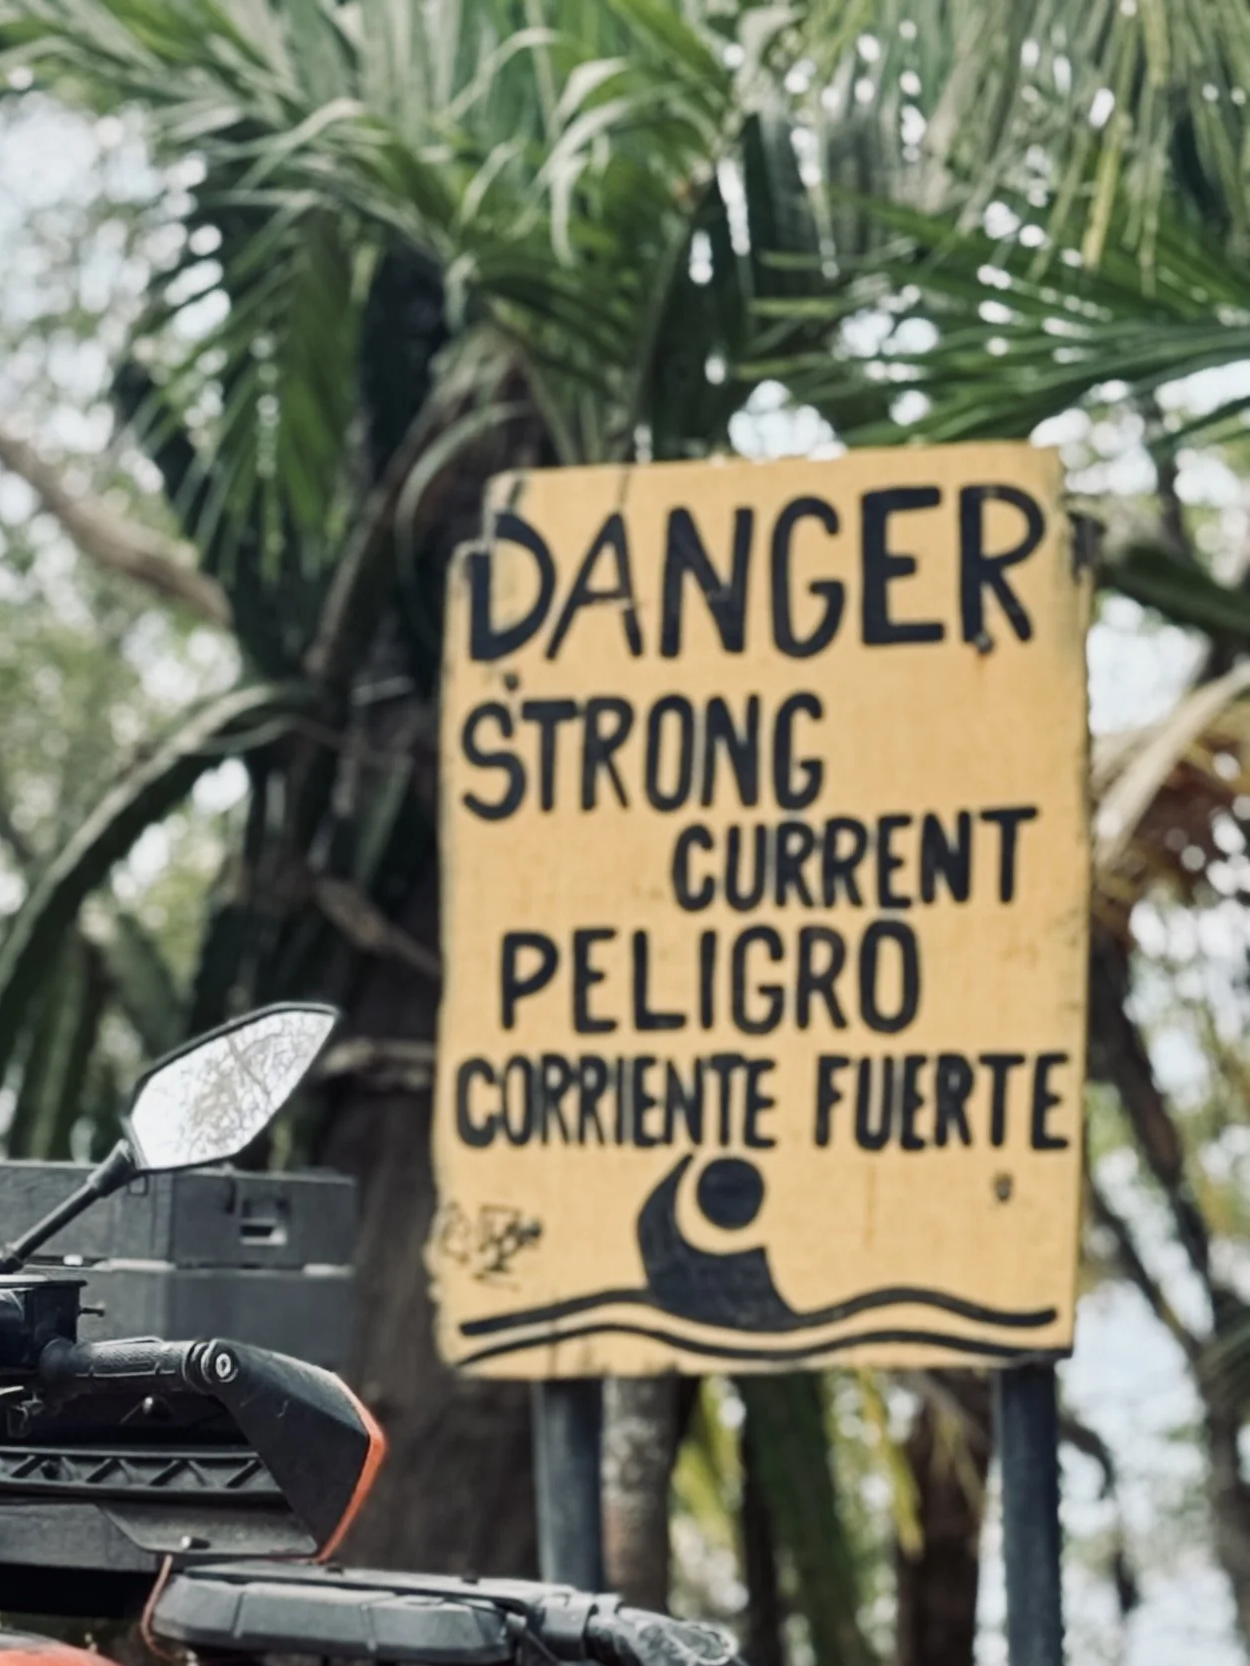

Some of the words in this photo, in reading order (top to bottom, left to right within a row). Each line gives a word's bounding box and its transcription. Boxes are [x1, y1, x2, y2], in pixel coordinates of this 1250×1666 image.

[467, 484, 1046, 662] DANGER
[460, 692, 824, 820] STRONG
[672, 807, 1039, 912] CURRENT
[501, 920, 922, 1035] PELIGRO
[455, 1054, 778, 1151] CORRIENTE
[814, 1052, 1071, 1152] FUERTE
